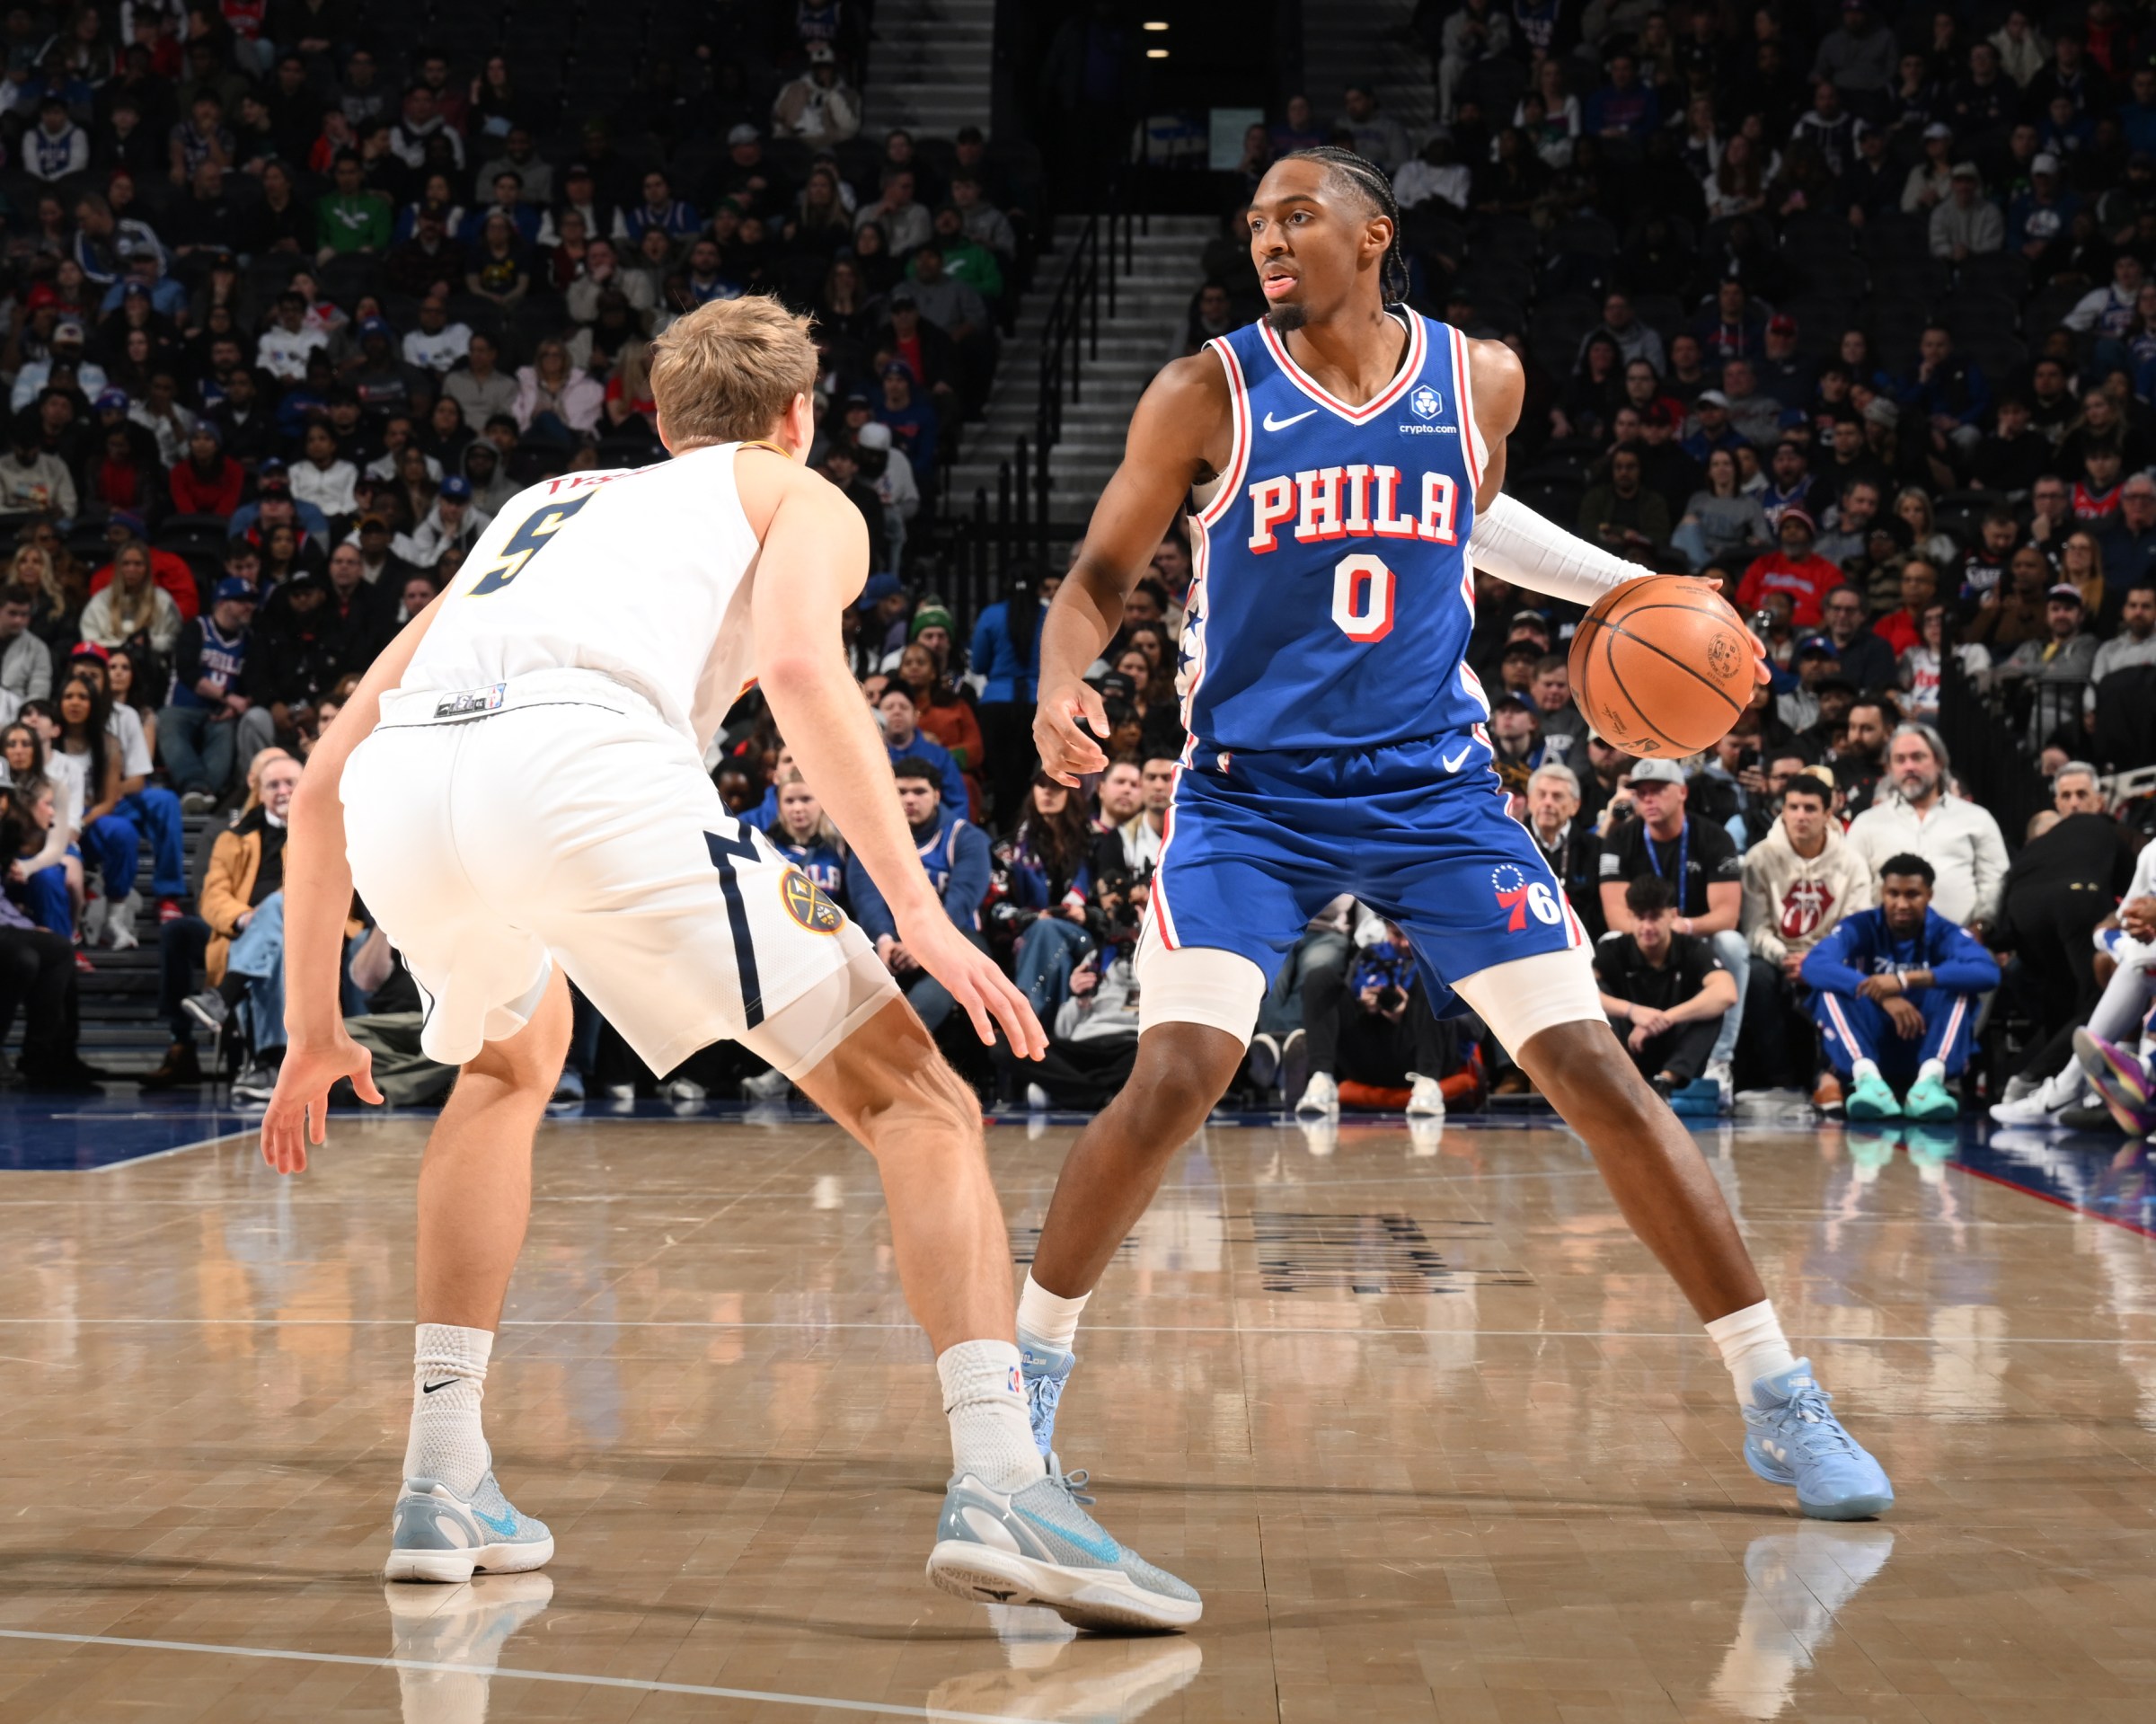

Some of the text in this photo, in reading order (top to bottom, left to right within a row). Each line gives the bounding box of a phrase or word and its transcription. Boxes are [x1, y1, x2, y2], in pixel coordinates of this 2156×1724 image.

[1399, 422, 1457, 435] crypto.com
[461, 486, 602, 598] 5
[1248, 464, 1459, 555] PHILA
[1331, 553, 1396, 643] 0
[1495, 882, 1561, 933] 76
